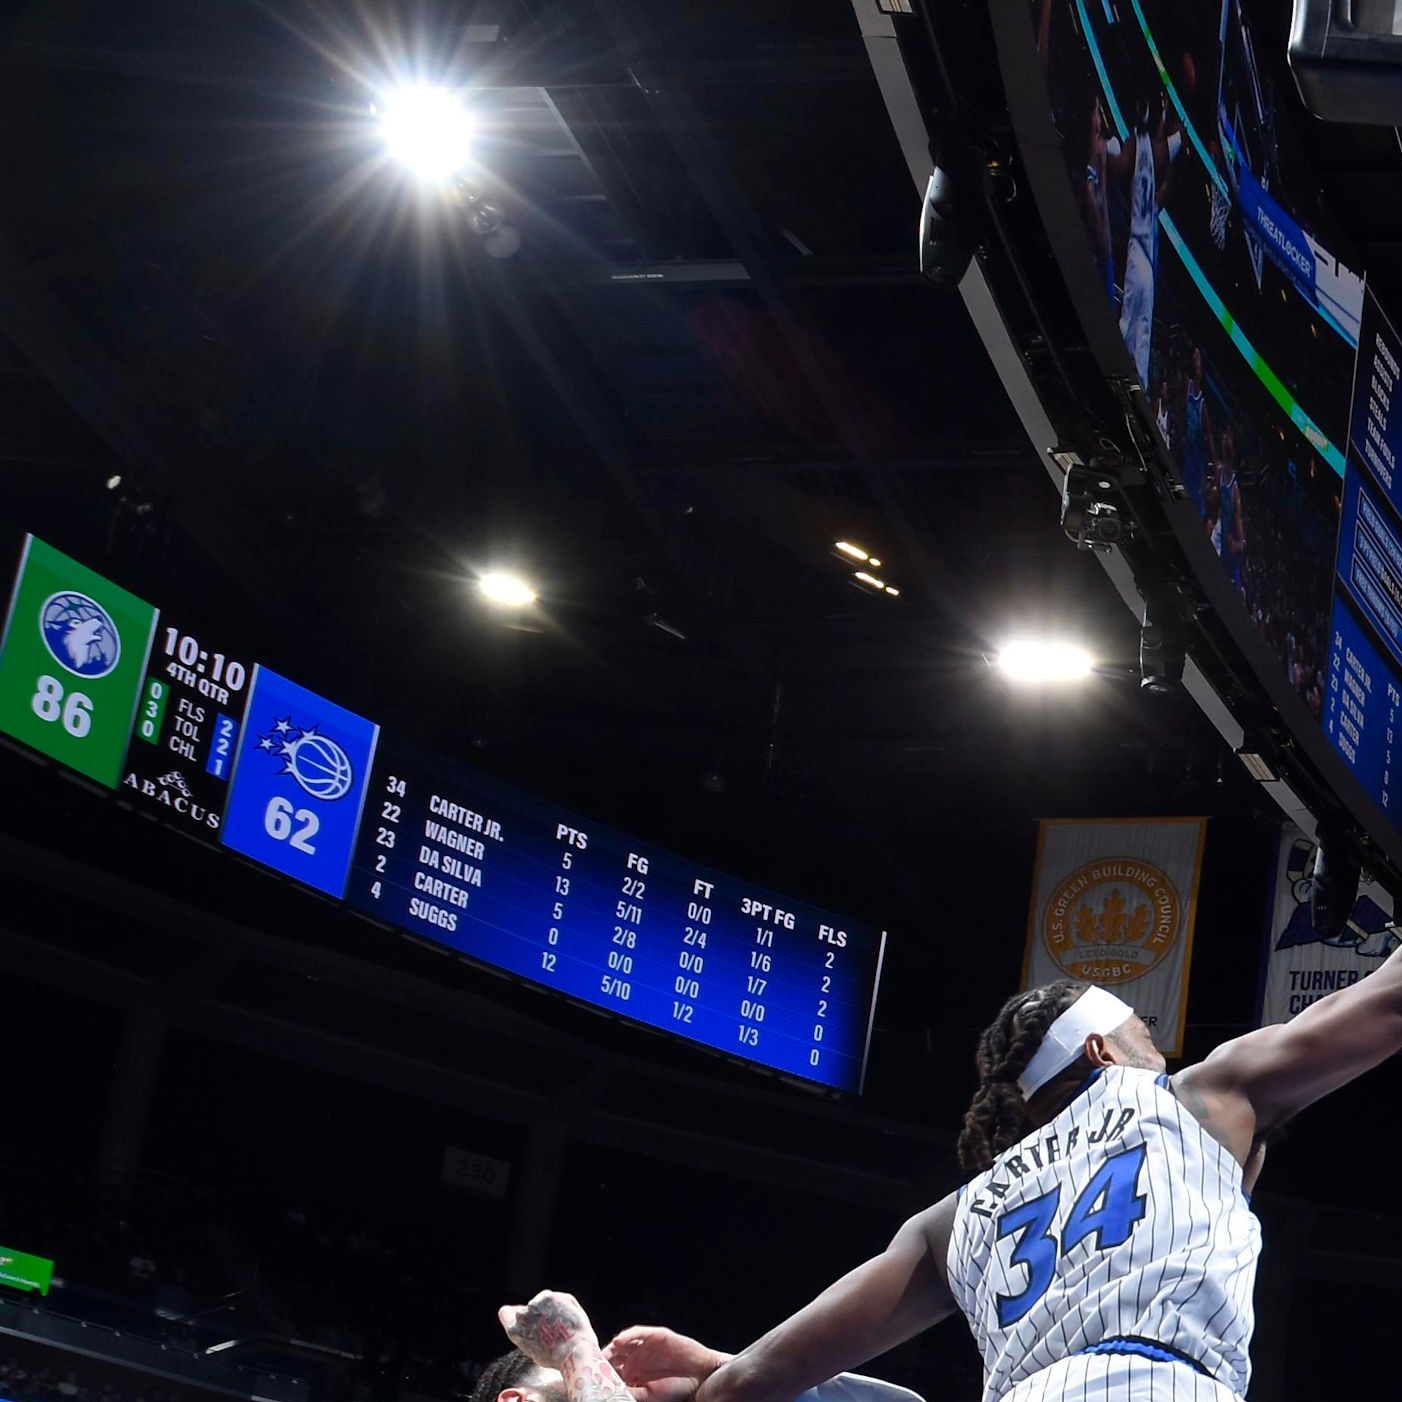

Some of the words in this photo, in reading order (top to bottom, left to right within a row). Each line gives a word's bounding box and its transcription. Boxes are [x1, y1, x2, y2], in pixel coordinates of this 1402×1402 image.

[164, 626, 246, 692] 10:10
[166, 661, 198, 694] 4TH
[199, 677, 230, 705] QTR
[30, 674, 95, 739] 86
[174, 715, 200, 742] TOL
[178, 698, 205, 722] FLS
[169, 735, 198, 762] CHL
[122, 771, 221, 830] ABACUS
[264, 796, 321, 856] 62
[387, 776, 407, 798] 34
[429, 795, 483, 833] CARTER
[377, 827, 395, 849] 23
[419, 845, 441, 869] DA
[442, 854, 482, 888] SILVA
[381, 802, 401, 823] 22
[424, 820, 485, 861] WAGNER
[408, 897, 458, 932] SUGGS
[414, 872, 469, 909] CARTER
[556, 823, 588, 850] PTS
[627, 852, 649, 875] FG
[693, 879, 714, 899] FT
[741, 897, 773, 923] 3PT
[774, 907, 796, 931] FG
[818, 923, 848, 948] FLS
[1055, 876, 1089, 916] GREEN
[1092, 866, 1157, 887] BUILDING
[1154, 888, 1172, 944] COUNCIL
[1082, 964, 1132, 977] USGBC
[1087, 1107, 1136, 1145] JR
[995, 1141, 1148, 1329] 34
